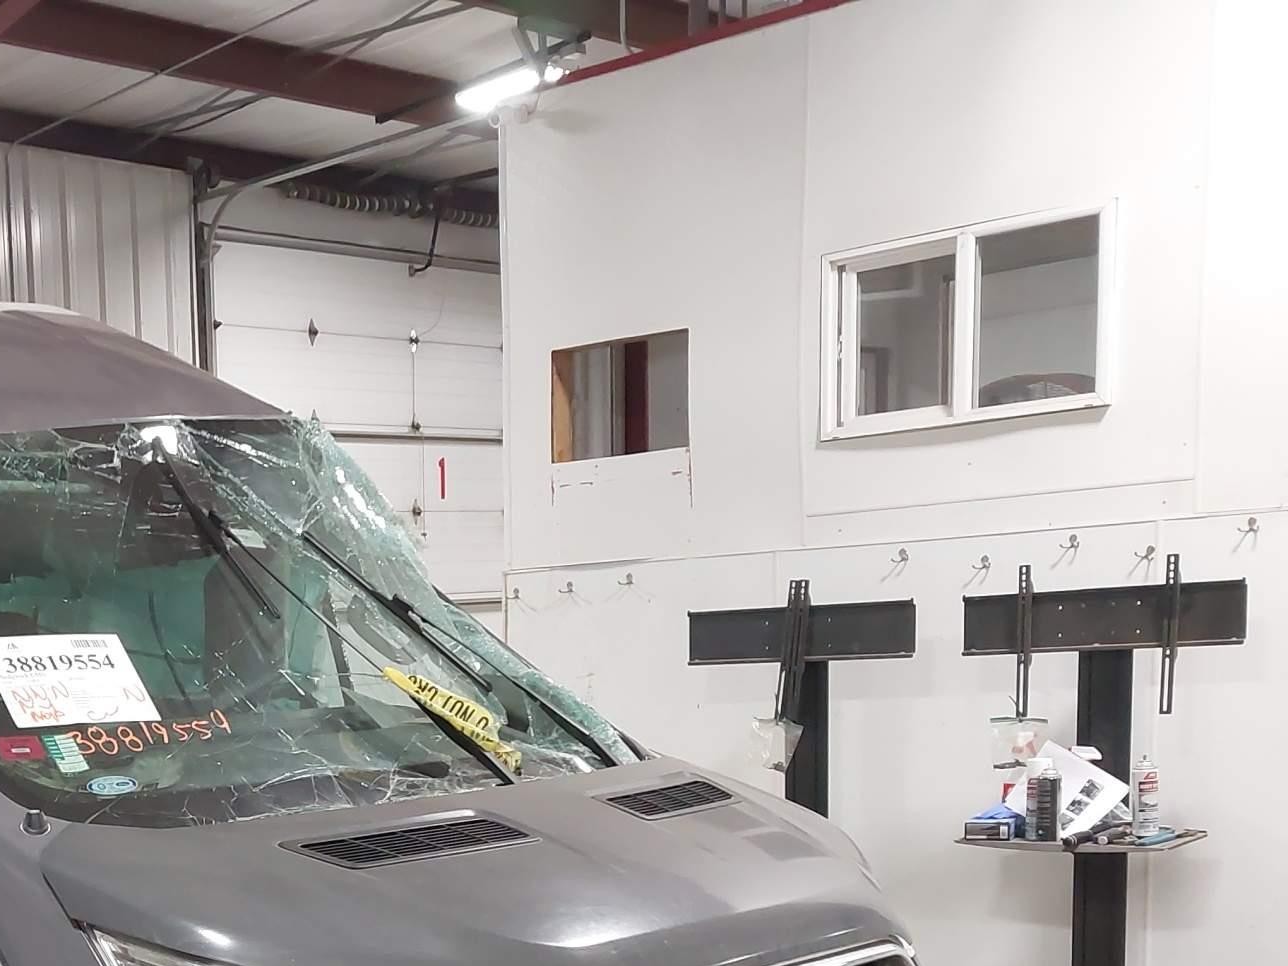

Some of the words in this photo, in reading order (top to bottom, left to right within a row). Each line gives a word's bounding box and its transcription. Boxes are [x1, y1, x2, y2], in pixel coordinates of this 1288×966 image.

[438, 456, 446, 500] 1
[2, 653, 115, 674] 38819554
[66, 708, 232, 755] 38819554
